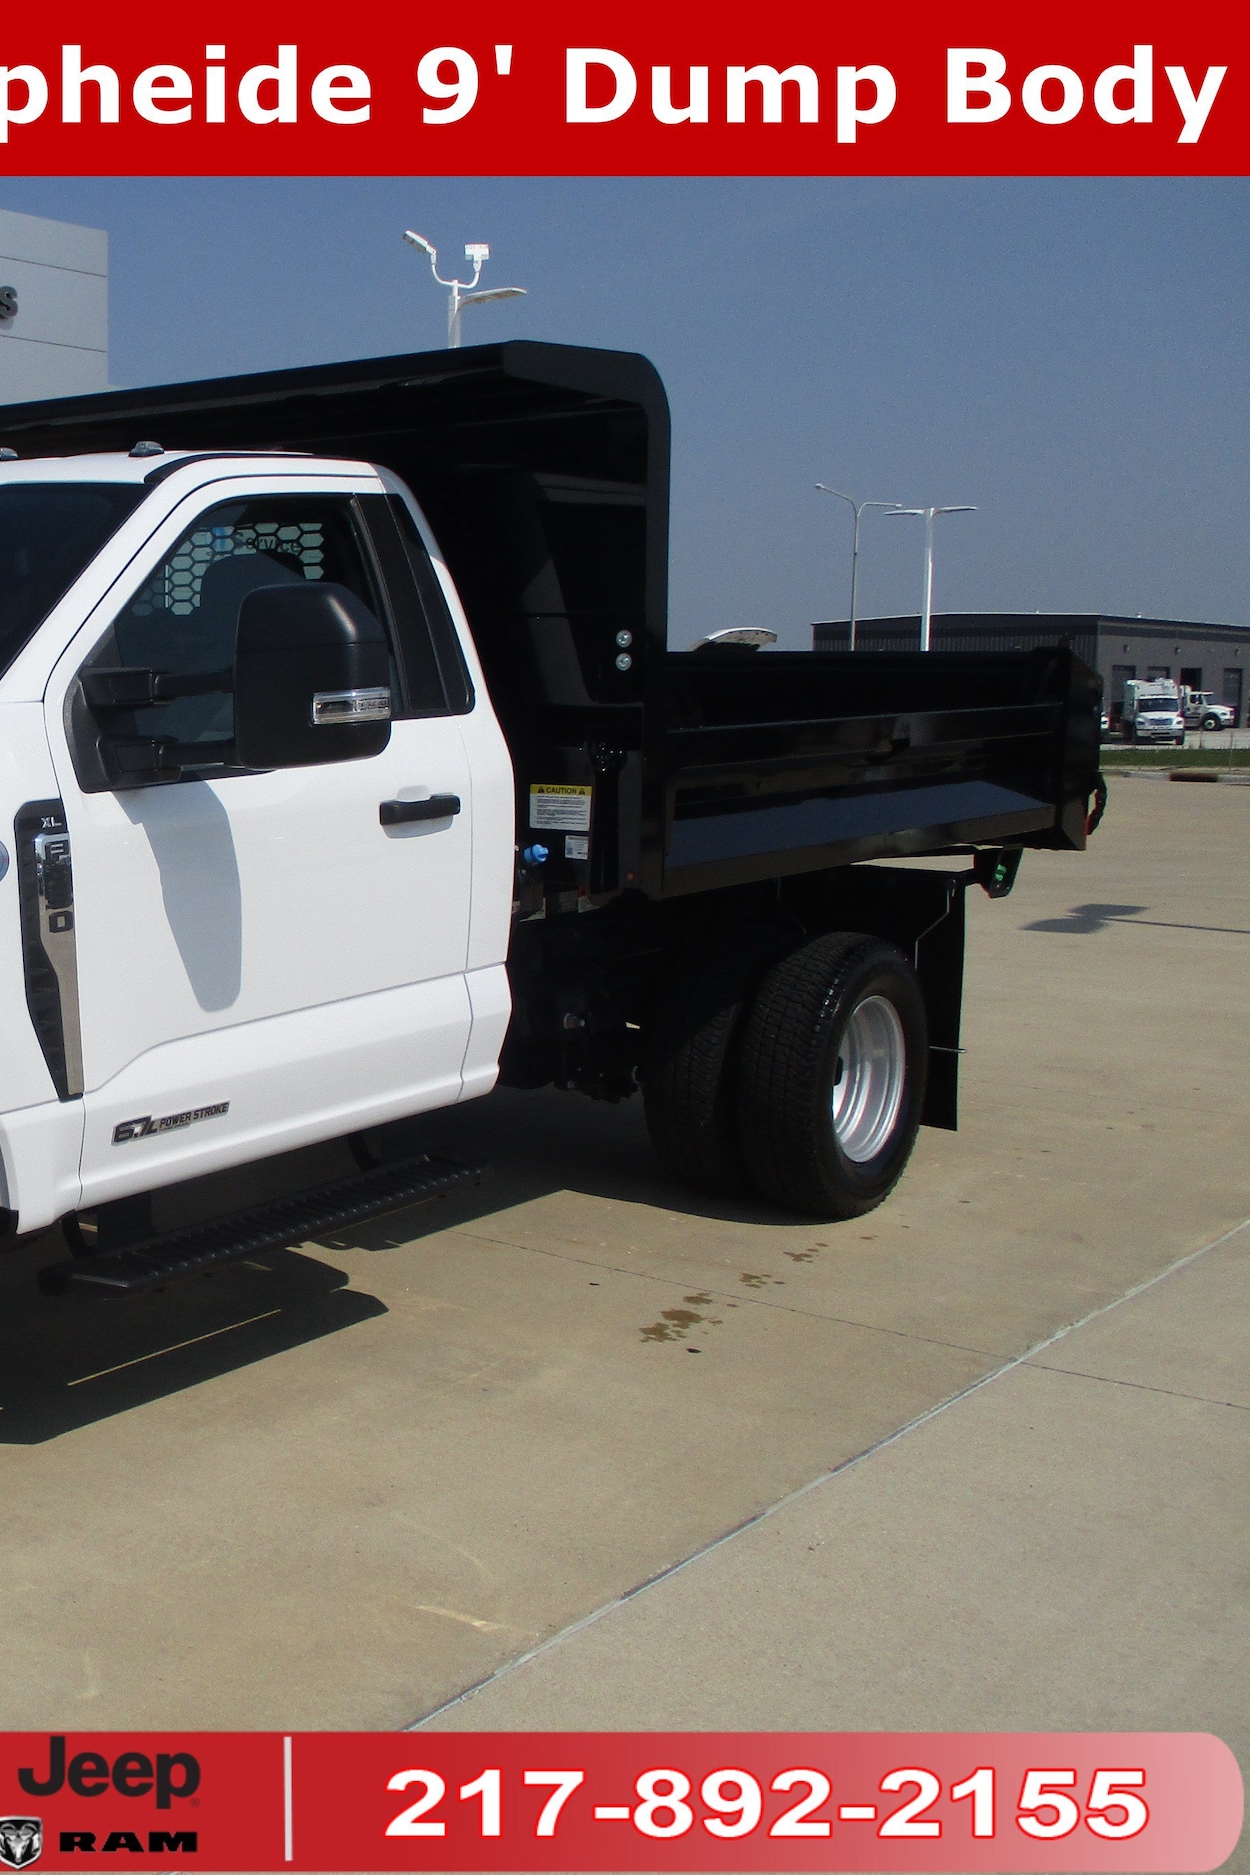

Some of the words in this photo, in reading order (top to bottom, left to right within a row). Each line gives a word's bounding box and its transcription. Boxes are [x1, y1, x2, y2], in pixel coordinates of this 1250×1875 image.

[545, 786, 577, 795] CAUTION
[40, 816, 62, 829] XL
[113, 1115, 158, 1142] 6.7L
[159, 1111, 191, 1129] POWER
[192, 1102, 229, 1120] STROKE
